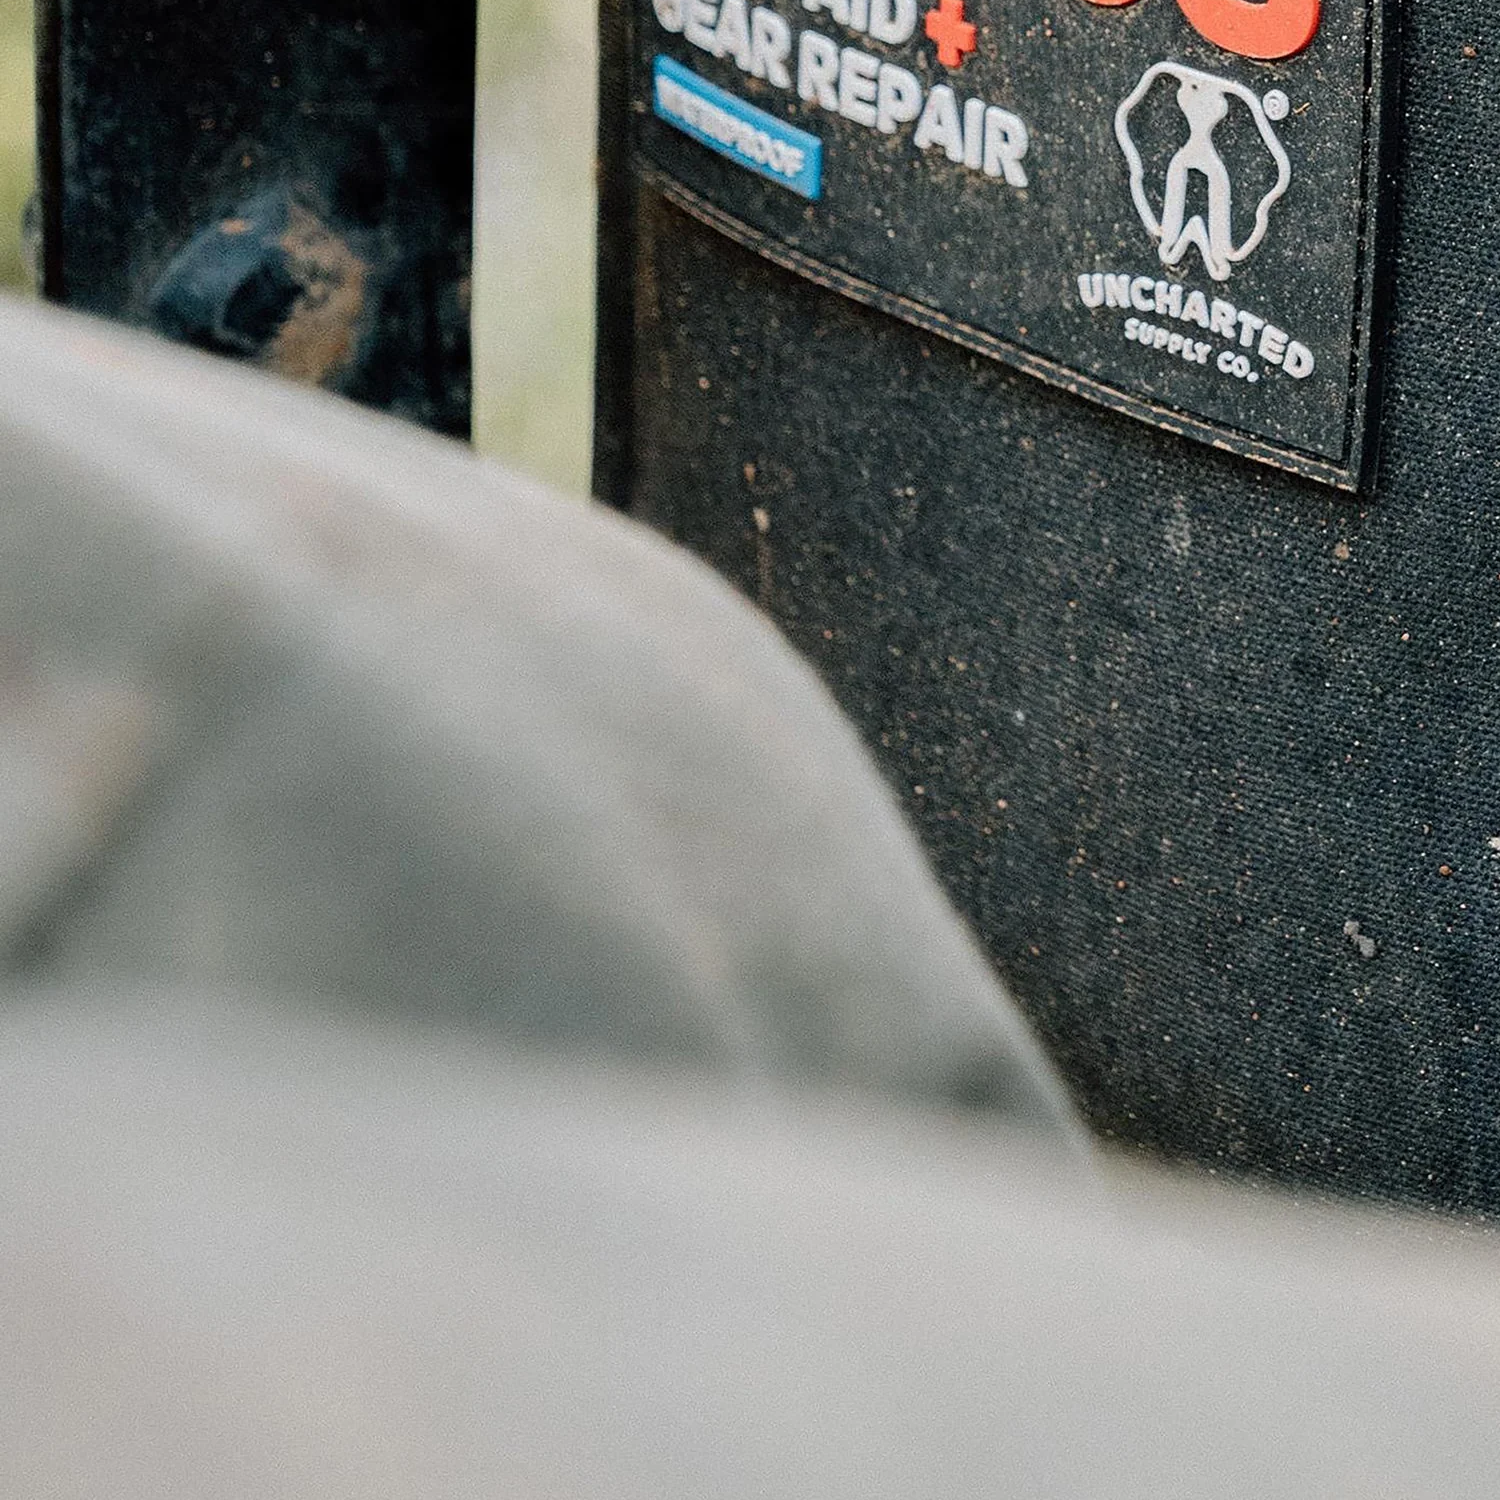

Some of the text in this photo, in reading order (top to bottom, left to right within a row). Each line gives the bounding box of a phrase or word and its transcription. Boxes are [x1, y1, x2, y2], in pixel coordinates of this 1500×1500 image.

[797, 29, 1029, 188] REPAIR
[1077, 273, 1314, 378] UNCHARTED
[1124, 318, 1259, 382] SUPPLY CO.
